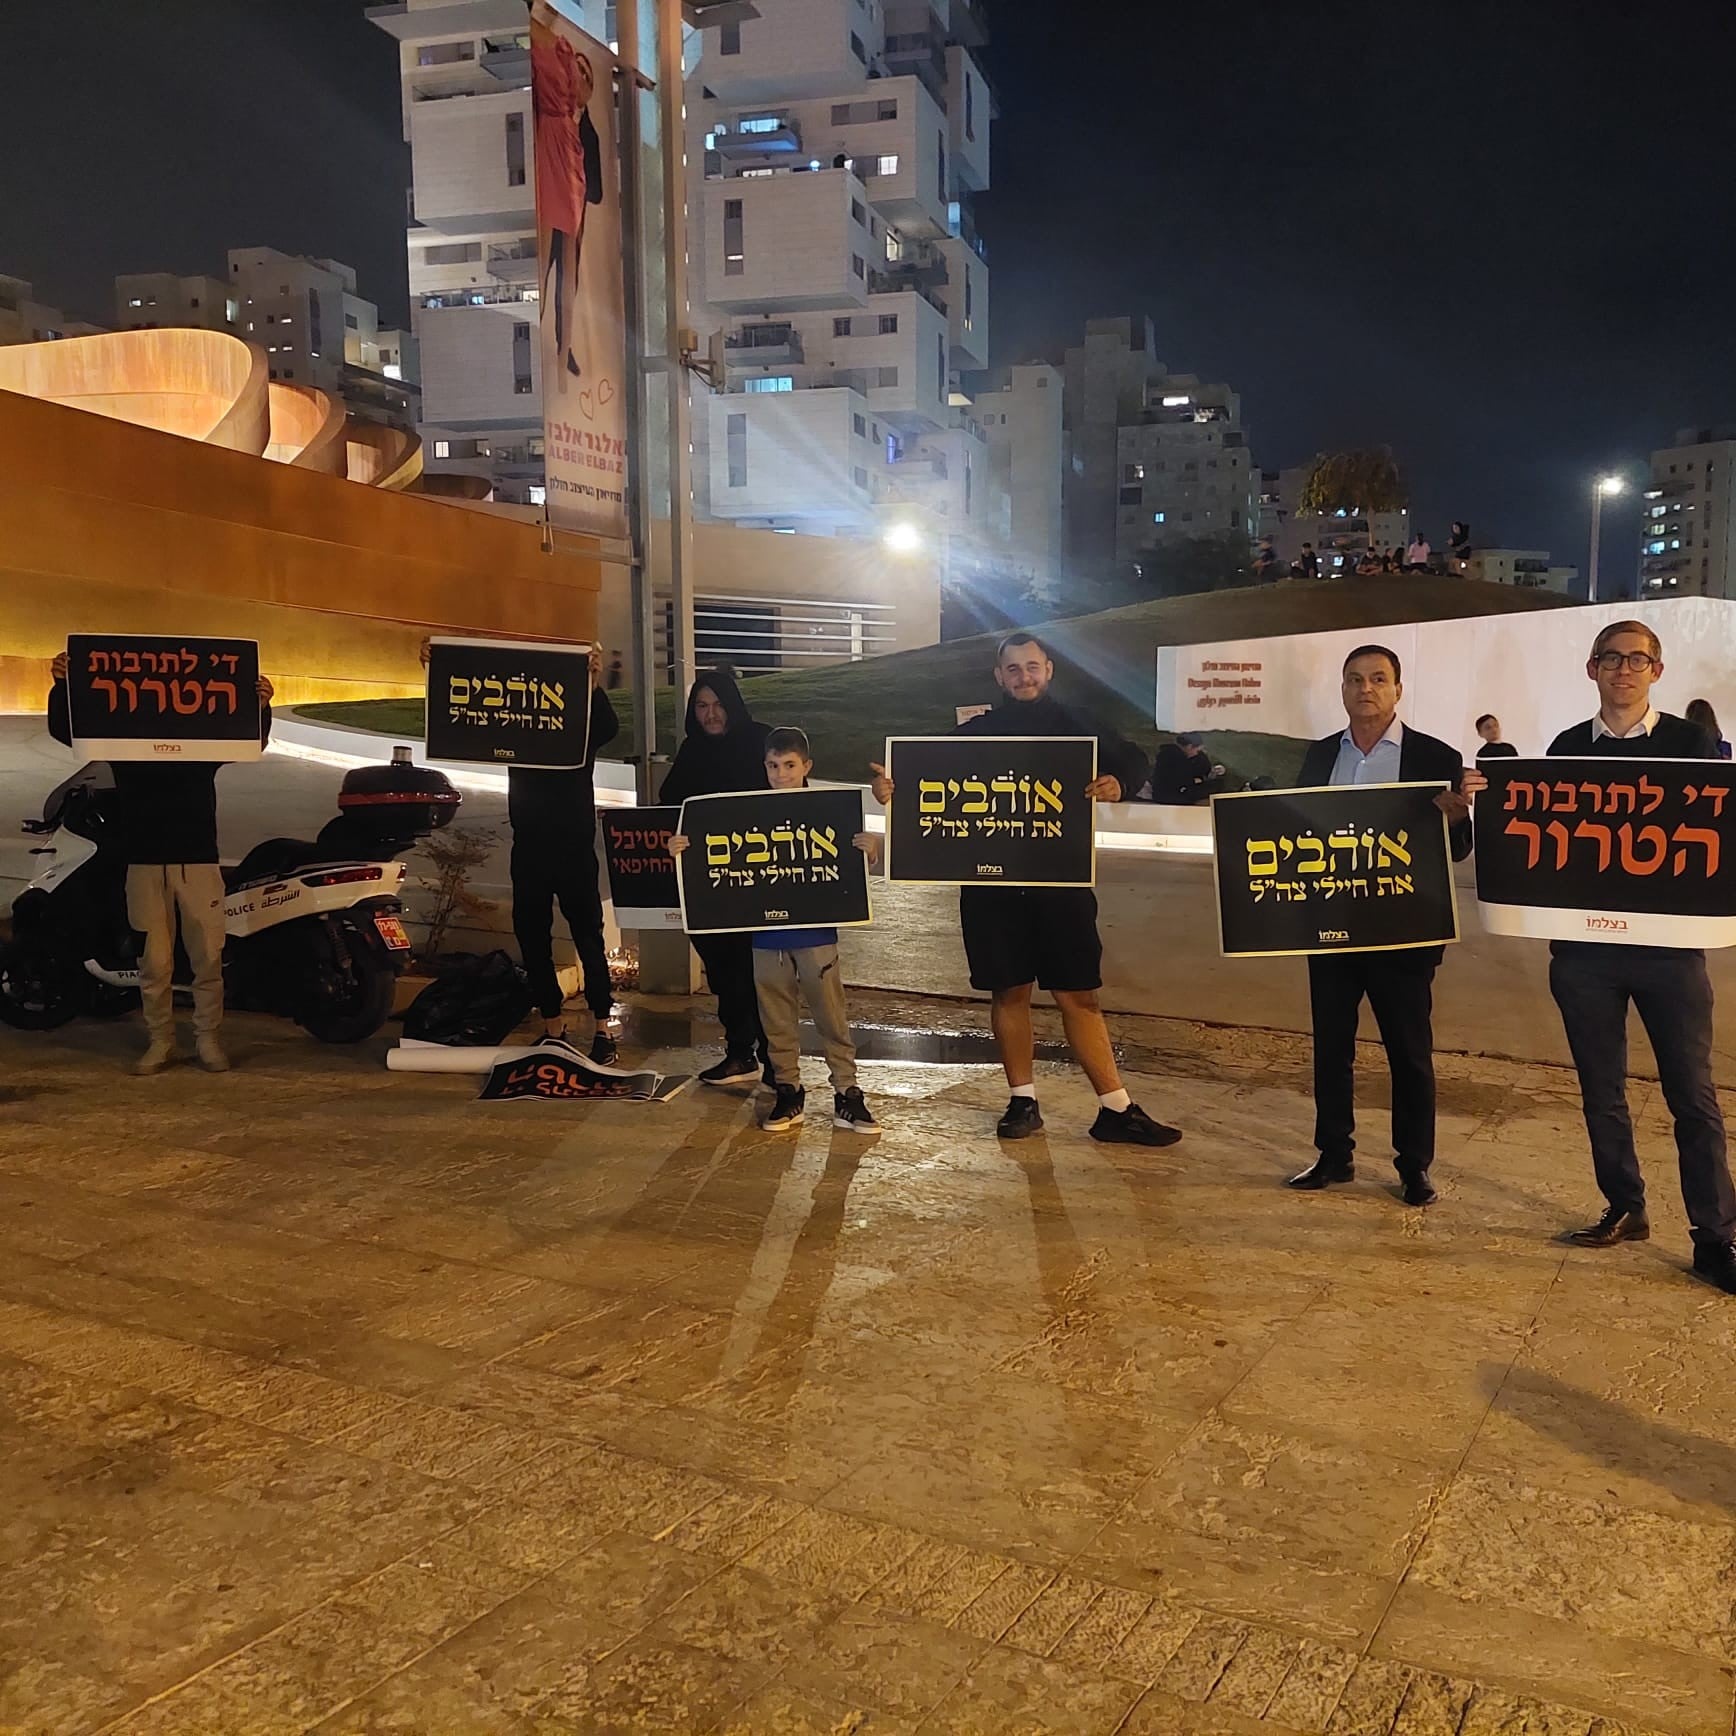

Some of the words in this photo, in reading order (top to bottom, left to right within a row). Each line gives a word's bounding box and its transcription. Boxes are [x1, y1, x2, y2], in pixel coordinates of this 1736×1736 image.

[586, 454, 623, 475] ELBAZ
[88, 648, 198, 675] לתרבות
[209, 653, 240, 675] די
[90, 676, 237, 715] הטרור
[493, 710, 533, 729] חיילי
[538, 715, 564, 730] את
[1503, 774, 1665, 816] לתרבות
[1682, 784, 1730, 817] די
[610, 824, 673, 850] סטיבל
[976, 816, 1025, 838] חיילי
[1031, 820, 1063, 838] את
[1503, 816, 1720, 879] הטרור
[759, 863, 805, 885] חיילי
[811, 864, 839, 882] את
[1312, 876, 1369, 900] חיילי
[1377, 873, 1414, 897] את
[1586, 915, 1629, 931] בצלמו
